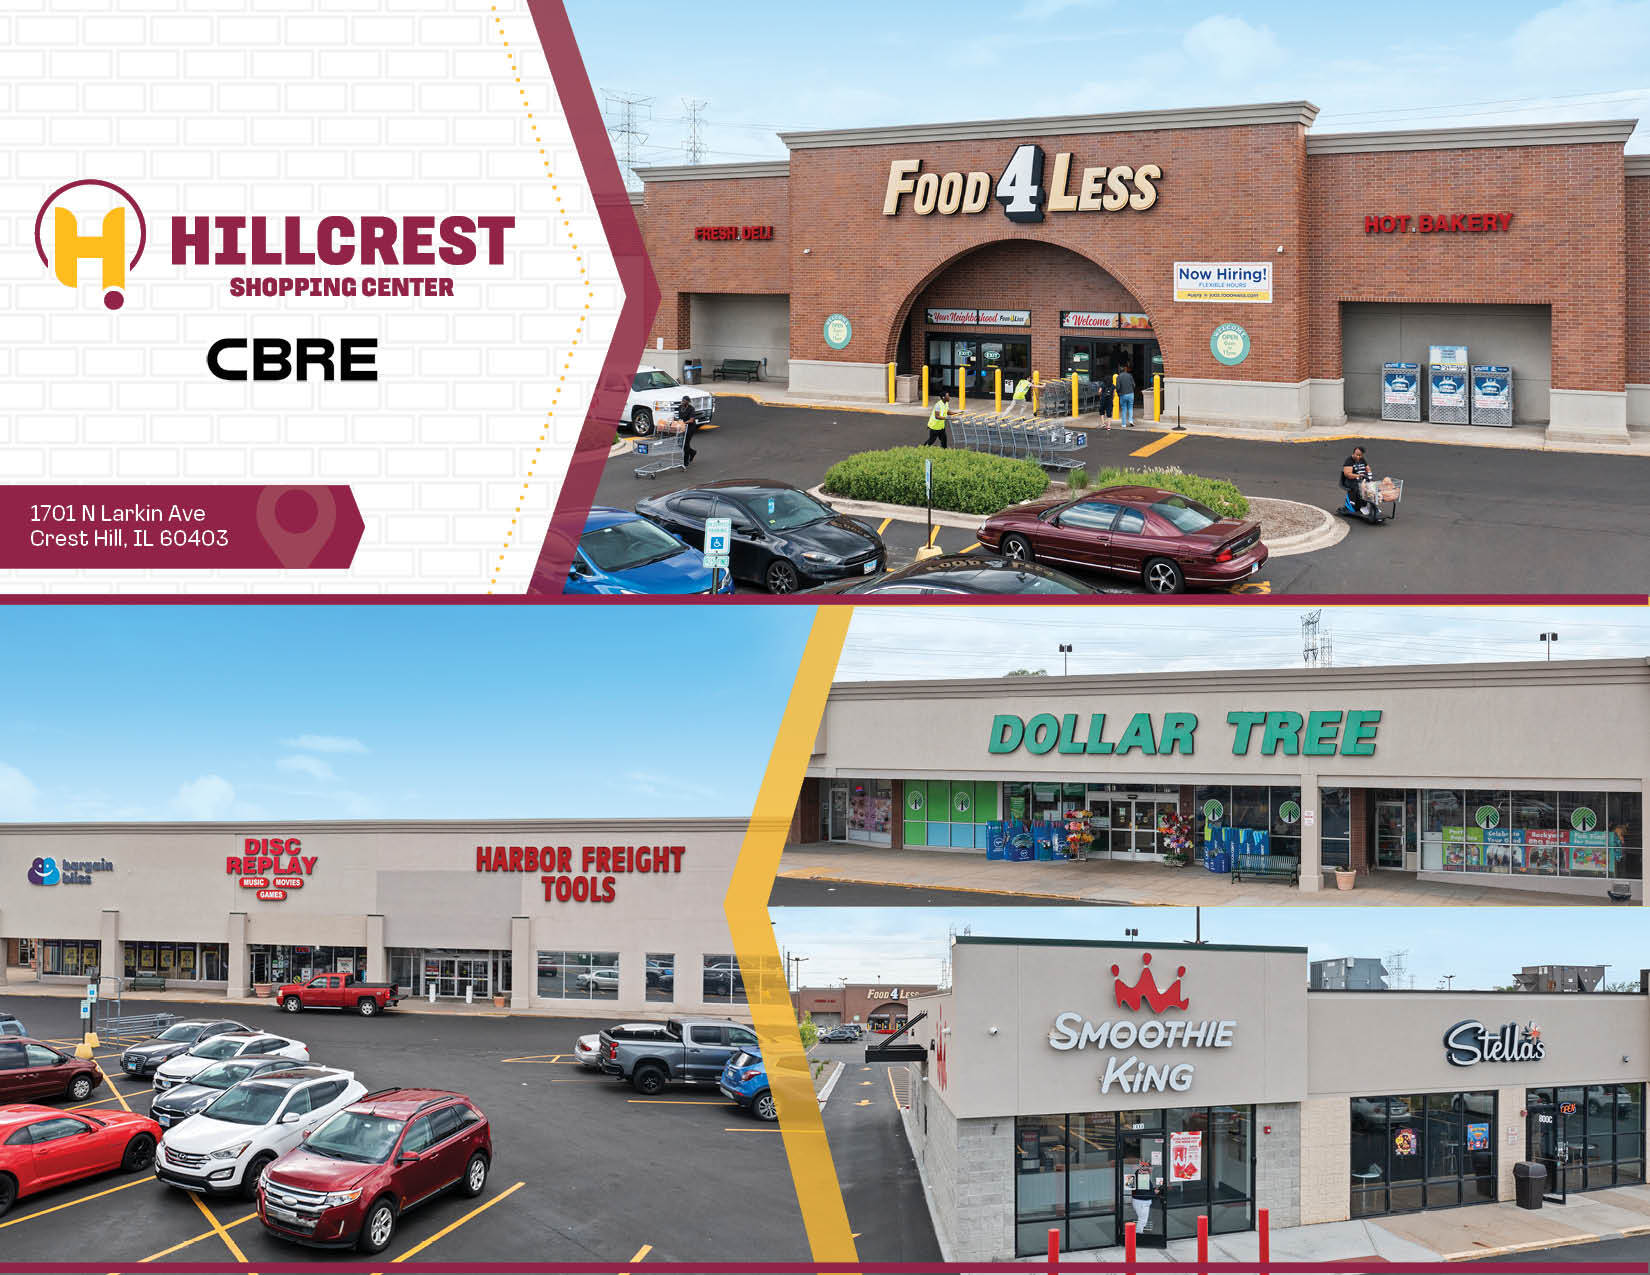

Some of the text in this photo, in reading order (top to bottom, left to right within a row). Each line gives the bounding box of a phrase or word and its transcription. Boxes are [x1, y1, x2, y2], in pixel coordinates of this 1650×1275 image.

[996, 144, 1045, 223] 4
[1365, 212, 1513, 234] HOT BAKERY
[695, 225, 774, 241] FRESH DELI
[1179, 267, 1267, 283] Now Hiring!
[933, 312, 950, 321] Your
[1072, 314, 1111, 327] Welcome
[988, 710, 1382, 756] DOLLAR TREE
[244, 838, 302, 856] DISC
[226, 856, 318, 876] REPLAY
[476, 845, 686, 873] HARBOR FREIGHT
[541, 875, 616, 903] TOOLS
[890, 987, 899, 1000] 4
[1049, 1012, 1238, 1050] SMOOTHIE
[1560, 1104, 1575, 1112] OPEN
